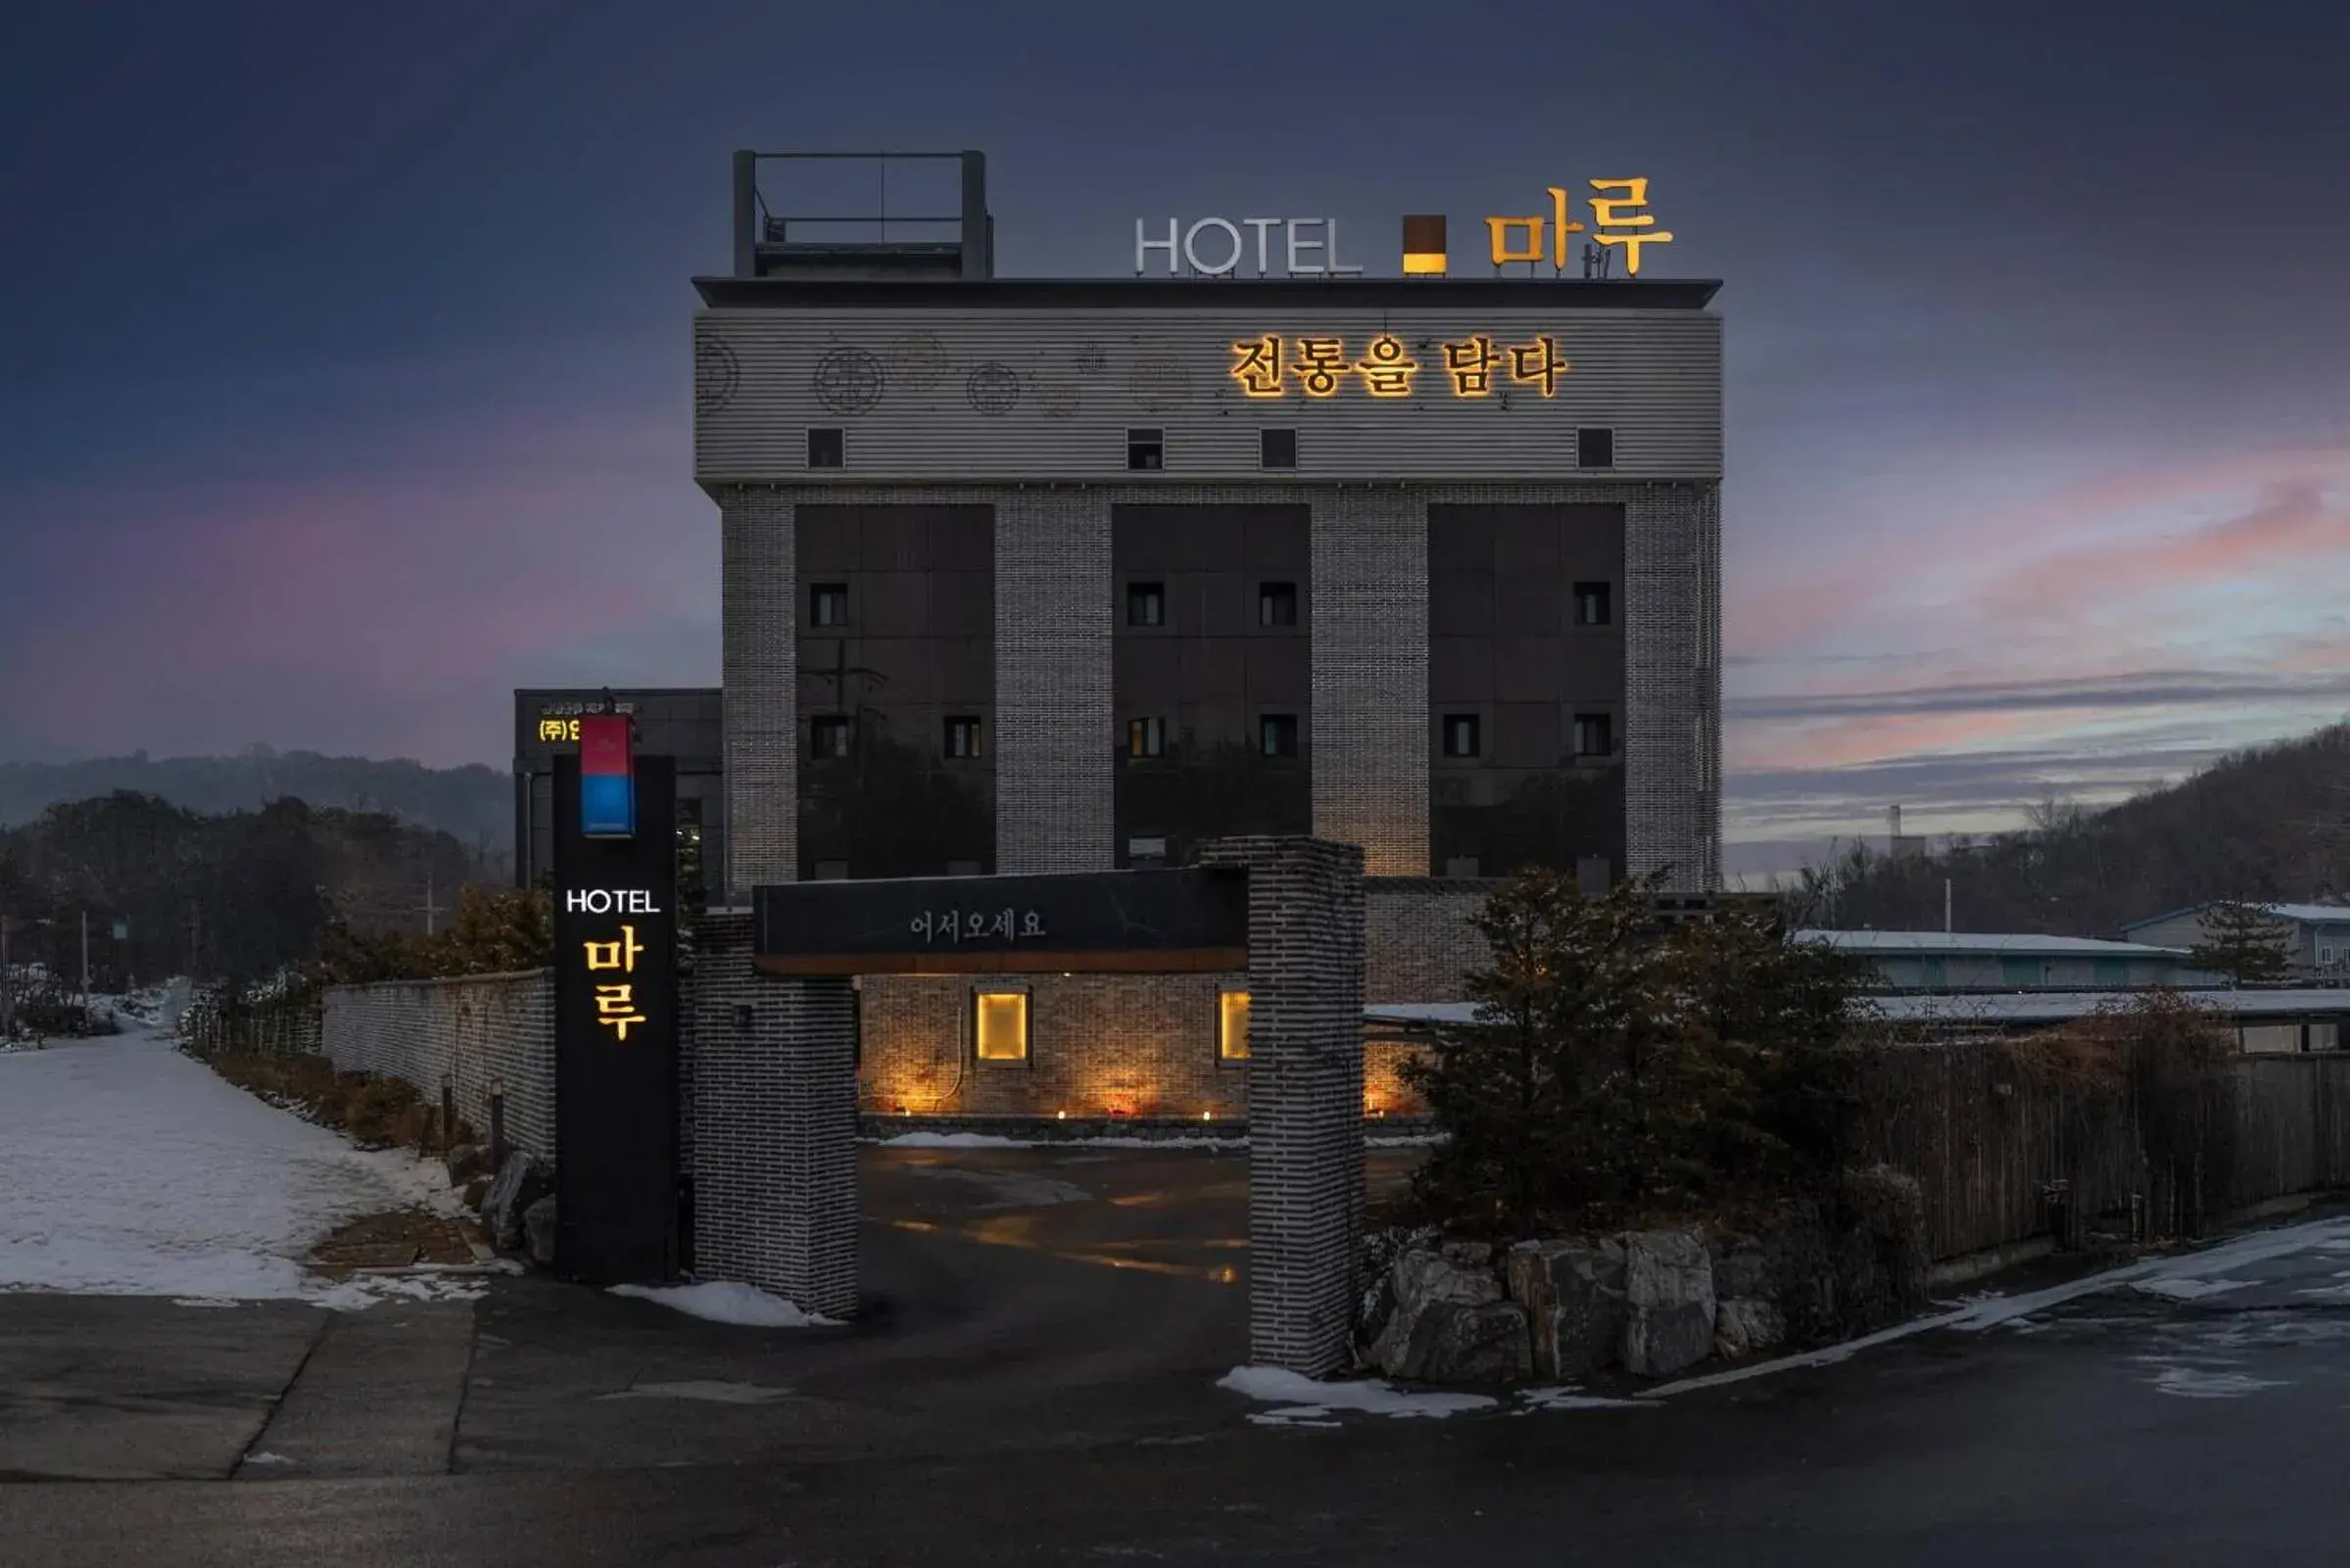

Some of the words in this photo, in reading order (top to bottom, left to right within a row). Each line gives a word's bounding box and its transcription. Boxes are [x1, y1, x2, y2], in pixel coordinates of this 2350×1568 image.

[1135, 217, 1364, 275] HOTEL
[1484, 177, 1674, 277] 마루
[1230, 335, 1416, 398] 전통을
[1442, 336, 1568, 399] 담다
[566, 889, 661, 914] HOTEL
[910, 907, 1046, 943] 어서오세요
[583, 925, 647, 1041] 마루
